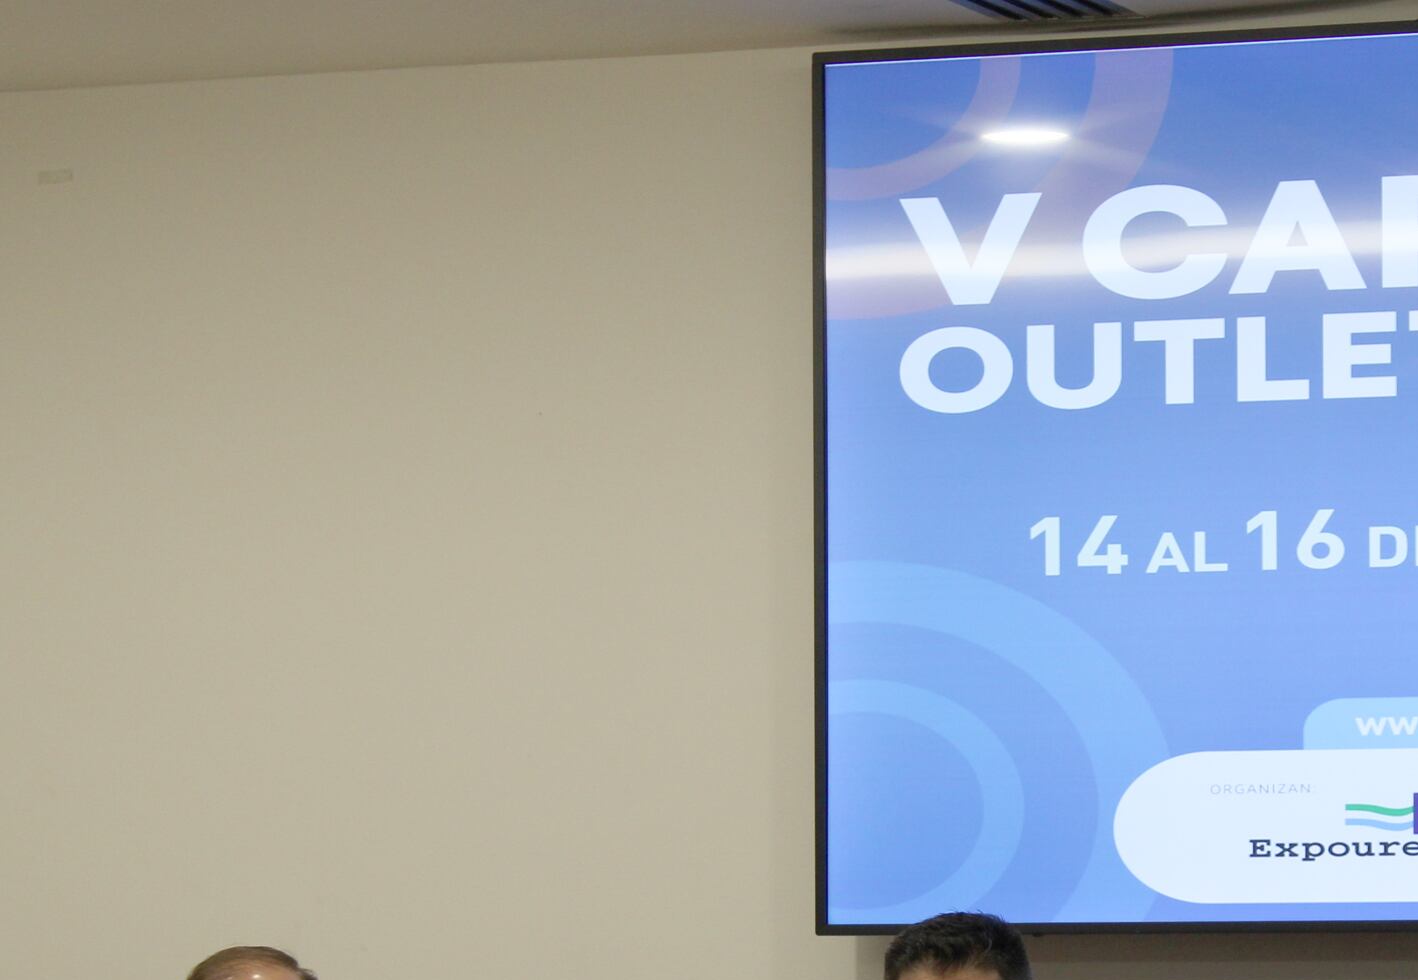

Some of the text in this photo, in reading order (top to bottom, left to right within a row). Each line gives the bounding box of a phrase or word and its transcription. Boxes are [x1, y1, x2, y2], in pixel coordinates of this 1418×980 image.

[899, 193, 1042, 305] V
[1029, 515, 1128, 576] 14
[1146, 531, 1228, 573] AL
[1245, 509, 1345, 571] 16
